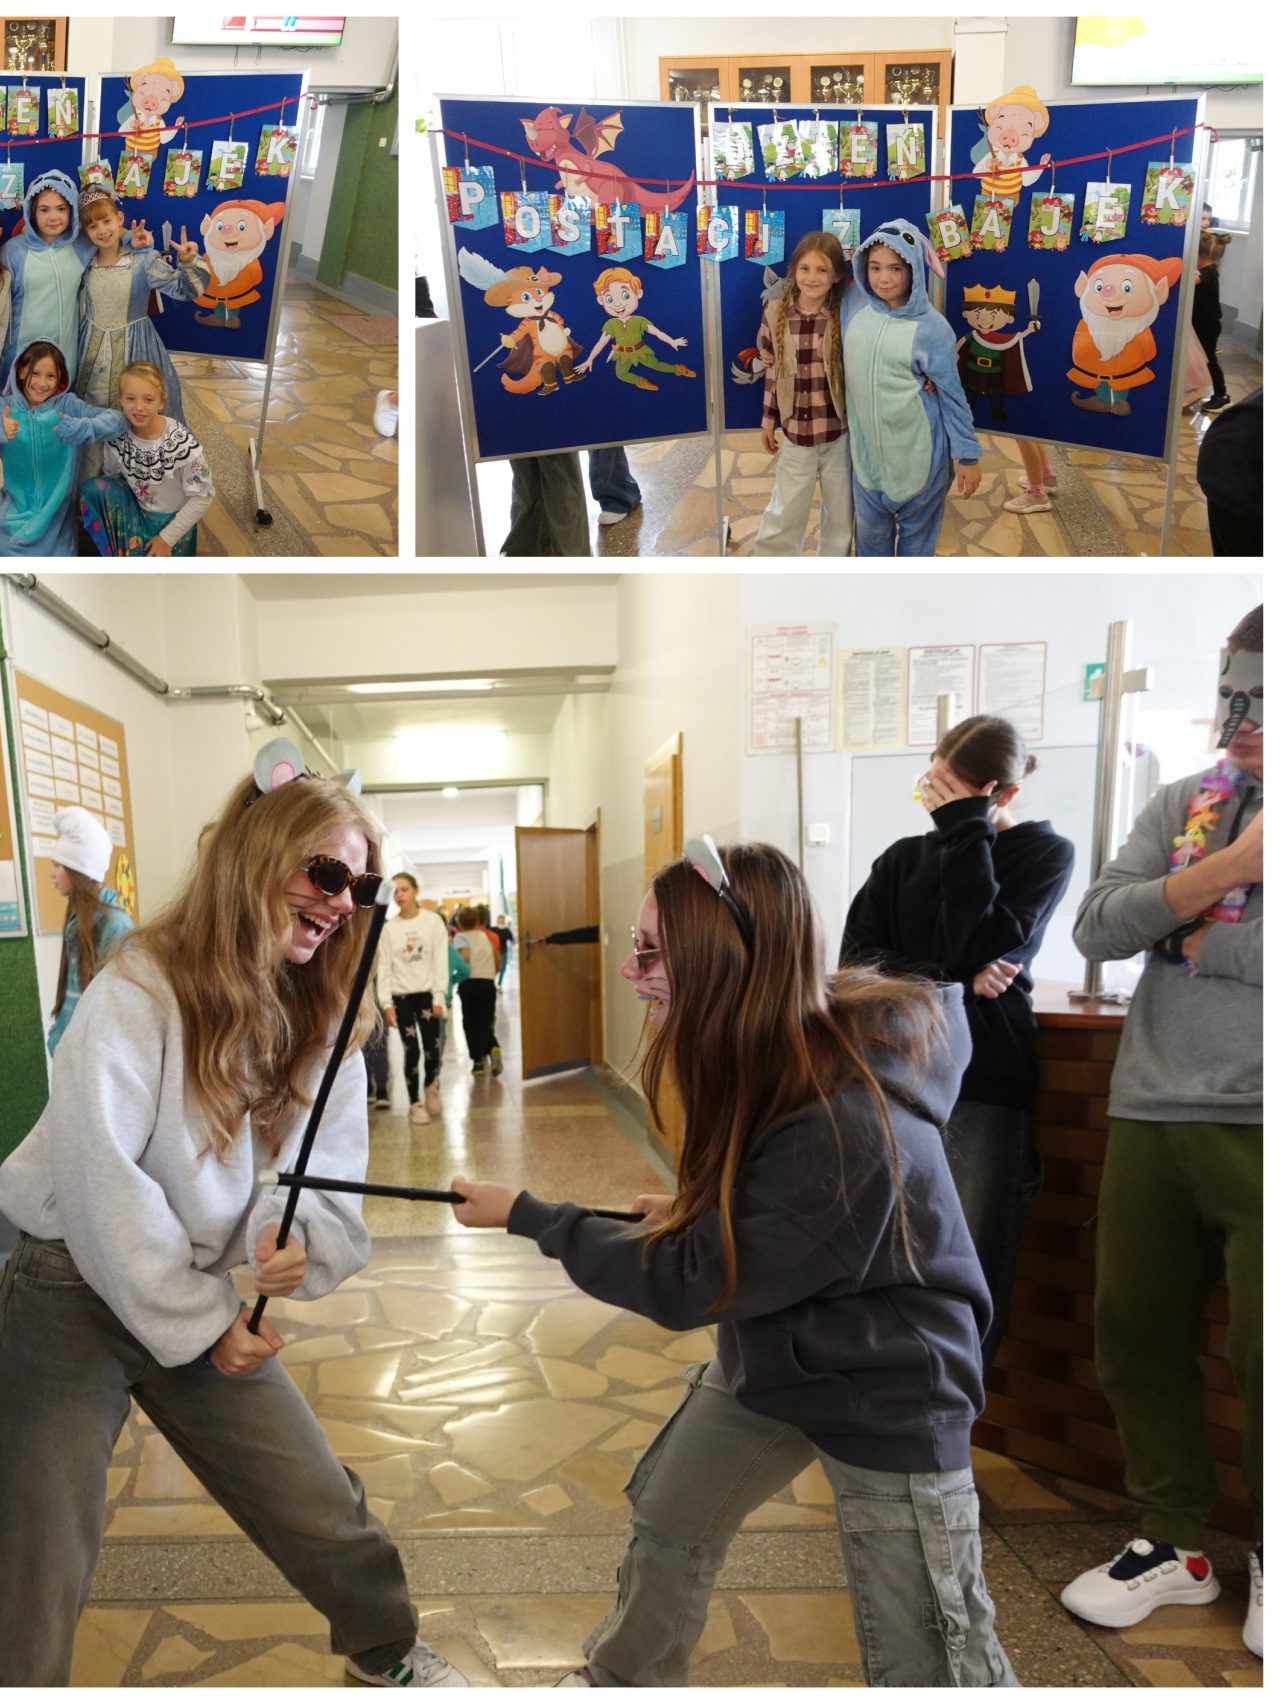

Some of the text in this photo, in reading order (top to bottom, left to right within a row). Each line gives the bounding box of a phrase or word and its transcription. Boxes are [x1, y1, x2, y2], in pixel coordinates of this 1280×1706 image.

[0, 172, 19, 200] Z
[459, 176, 1181, 257] POSTACI Z BAJEK
